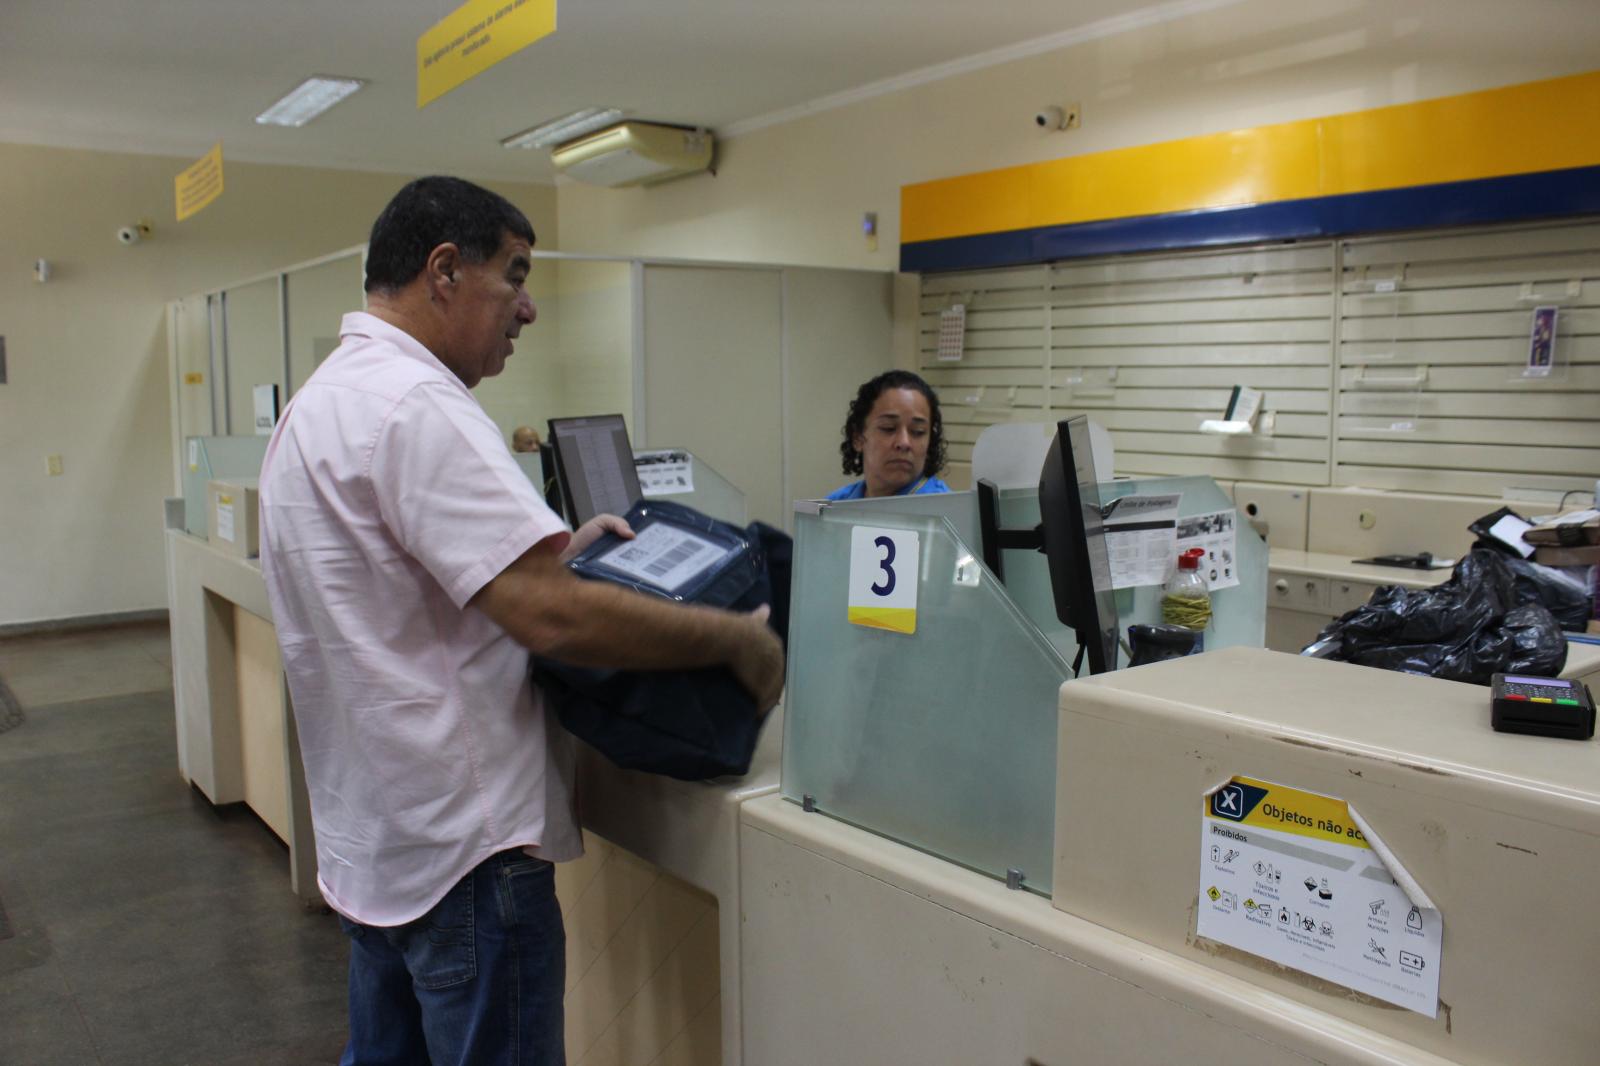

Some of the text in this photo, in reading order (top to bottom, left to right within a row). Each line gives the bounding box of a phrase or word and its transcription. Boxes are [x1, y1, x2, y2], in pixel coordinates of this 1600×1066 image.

[870, 535, 896, 596] 3
[1213, 825, 1248, 843] Proibidos
[1262, 803, 1313, 827] Objetos
[1317, 819, 1342, 835] não
